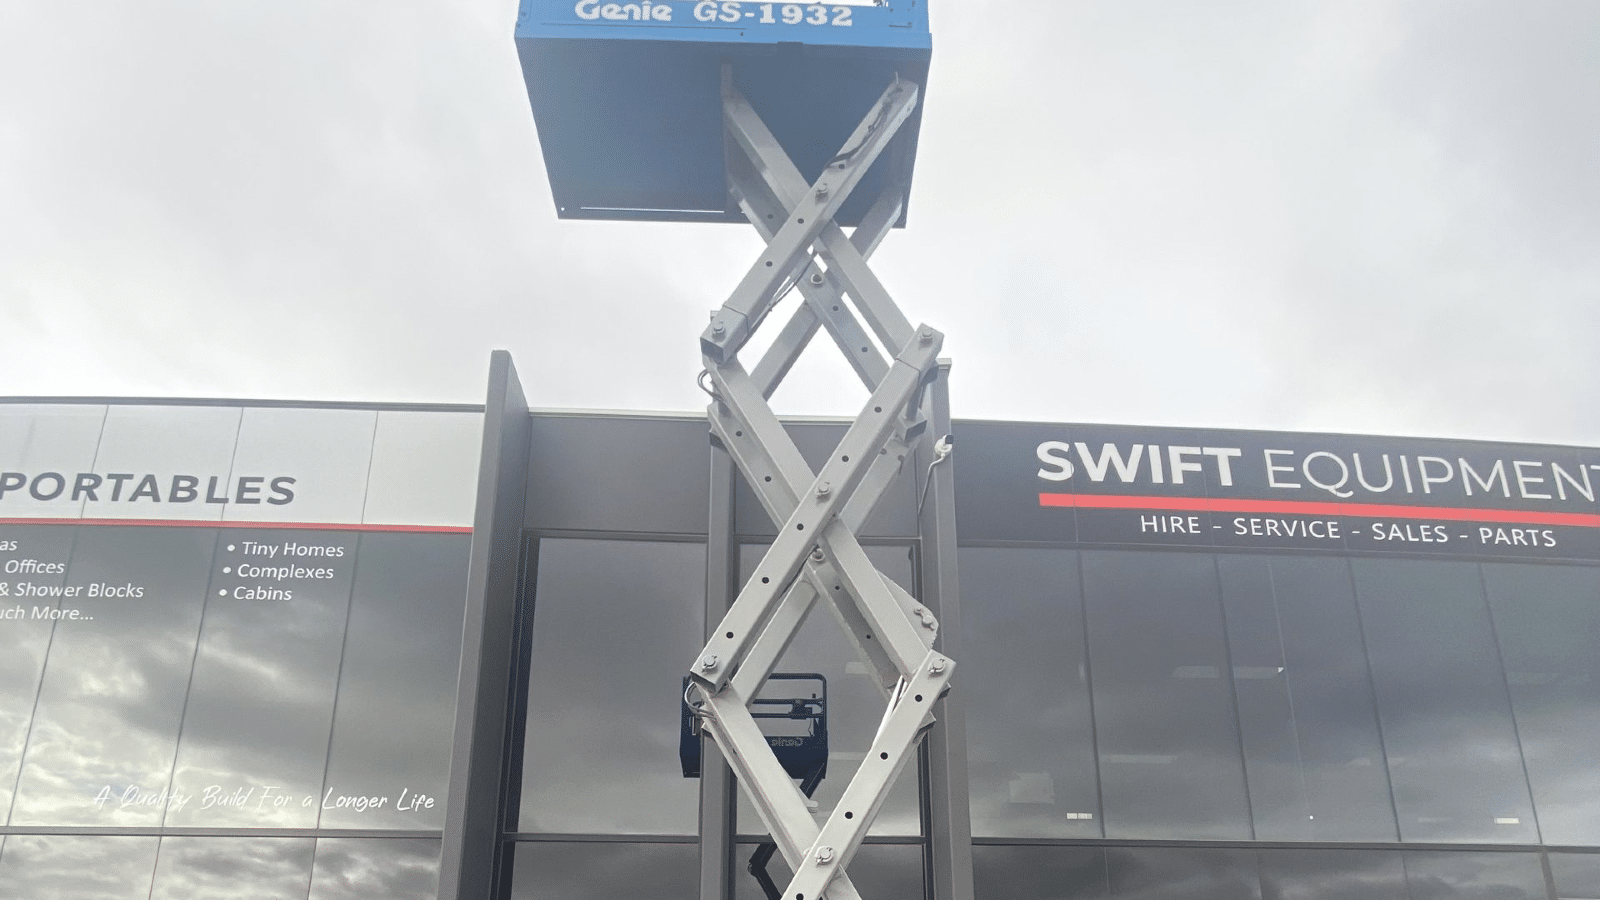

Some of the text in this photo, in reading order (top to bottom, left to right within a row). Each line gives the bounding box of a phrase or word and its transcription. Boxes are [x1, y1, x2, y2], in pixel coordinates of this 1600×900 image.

[575, 0, 853, 27] Genie GS-1932
[1036, 440, 1242, 487] SWIFT
[0, 471, 297, 505] PORTABLES
[1140, 515, 1201, 534] HIRE
[1233, 517, 1340, 538] SERVICE
[1371, 523, 1449, 543] SALES
[1479, 527, 1557, 547] PARTS
[242, 541, 344, 558] Tiny Homes
[5, 559, 66, 574] Offices
[237, 563, 334, 581] Complexes
[14, 582, 83, 597] Shower
[88, 583, 144, 598] Blocks
[233, 585, 293, 600] Cabins
[31, 606, 94, 620] More...
[93, 784, 435, 813] A Quality Build For a Longer Life
